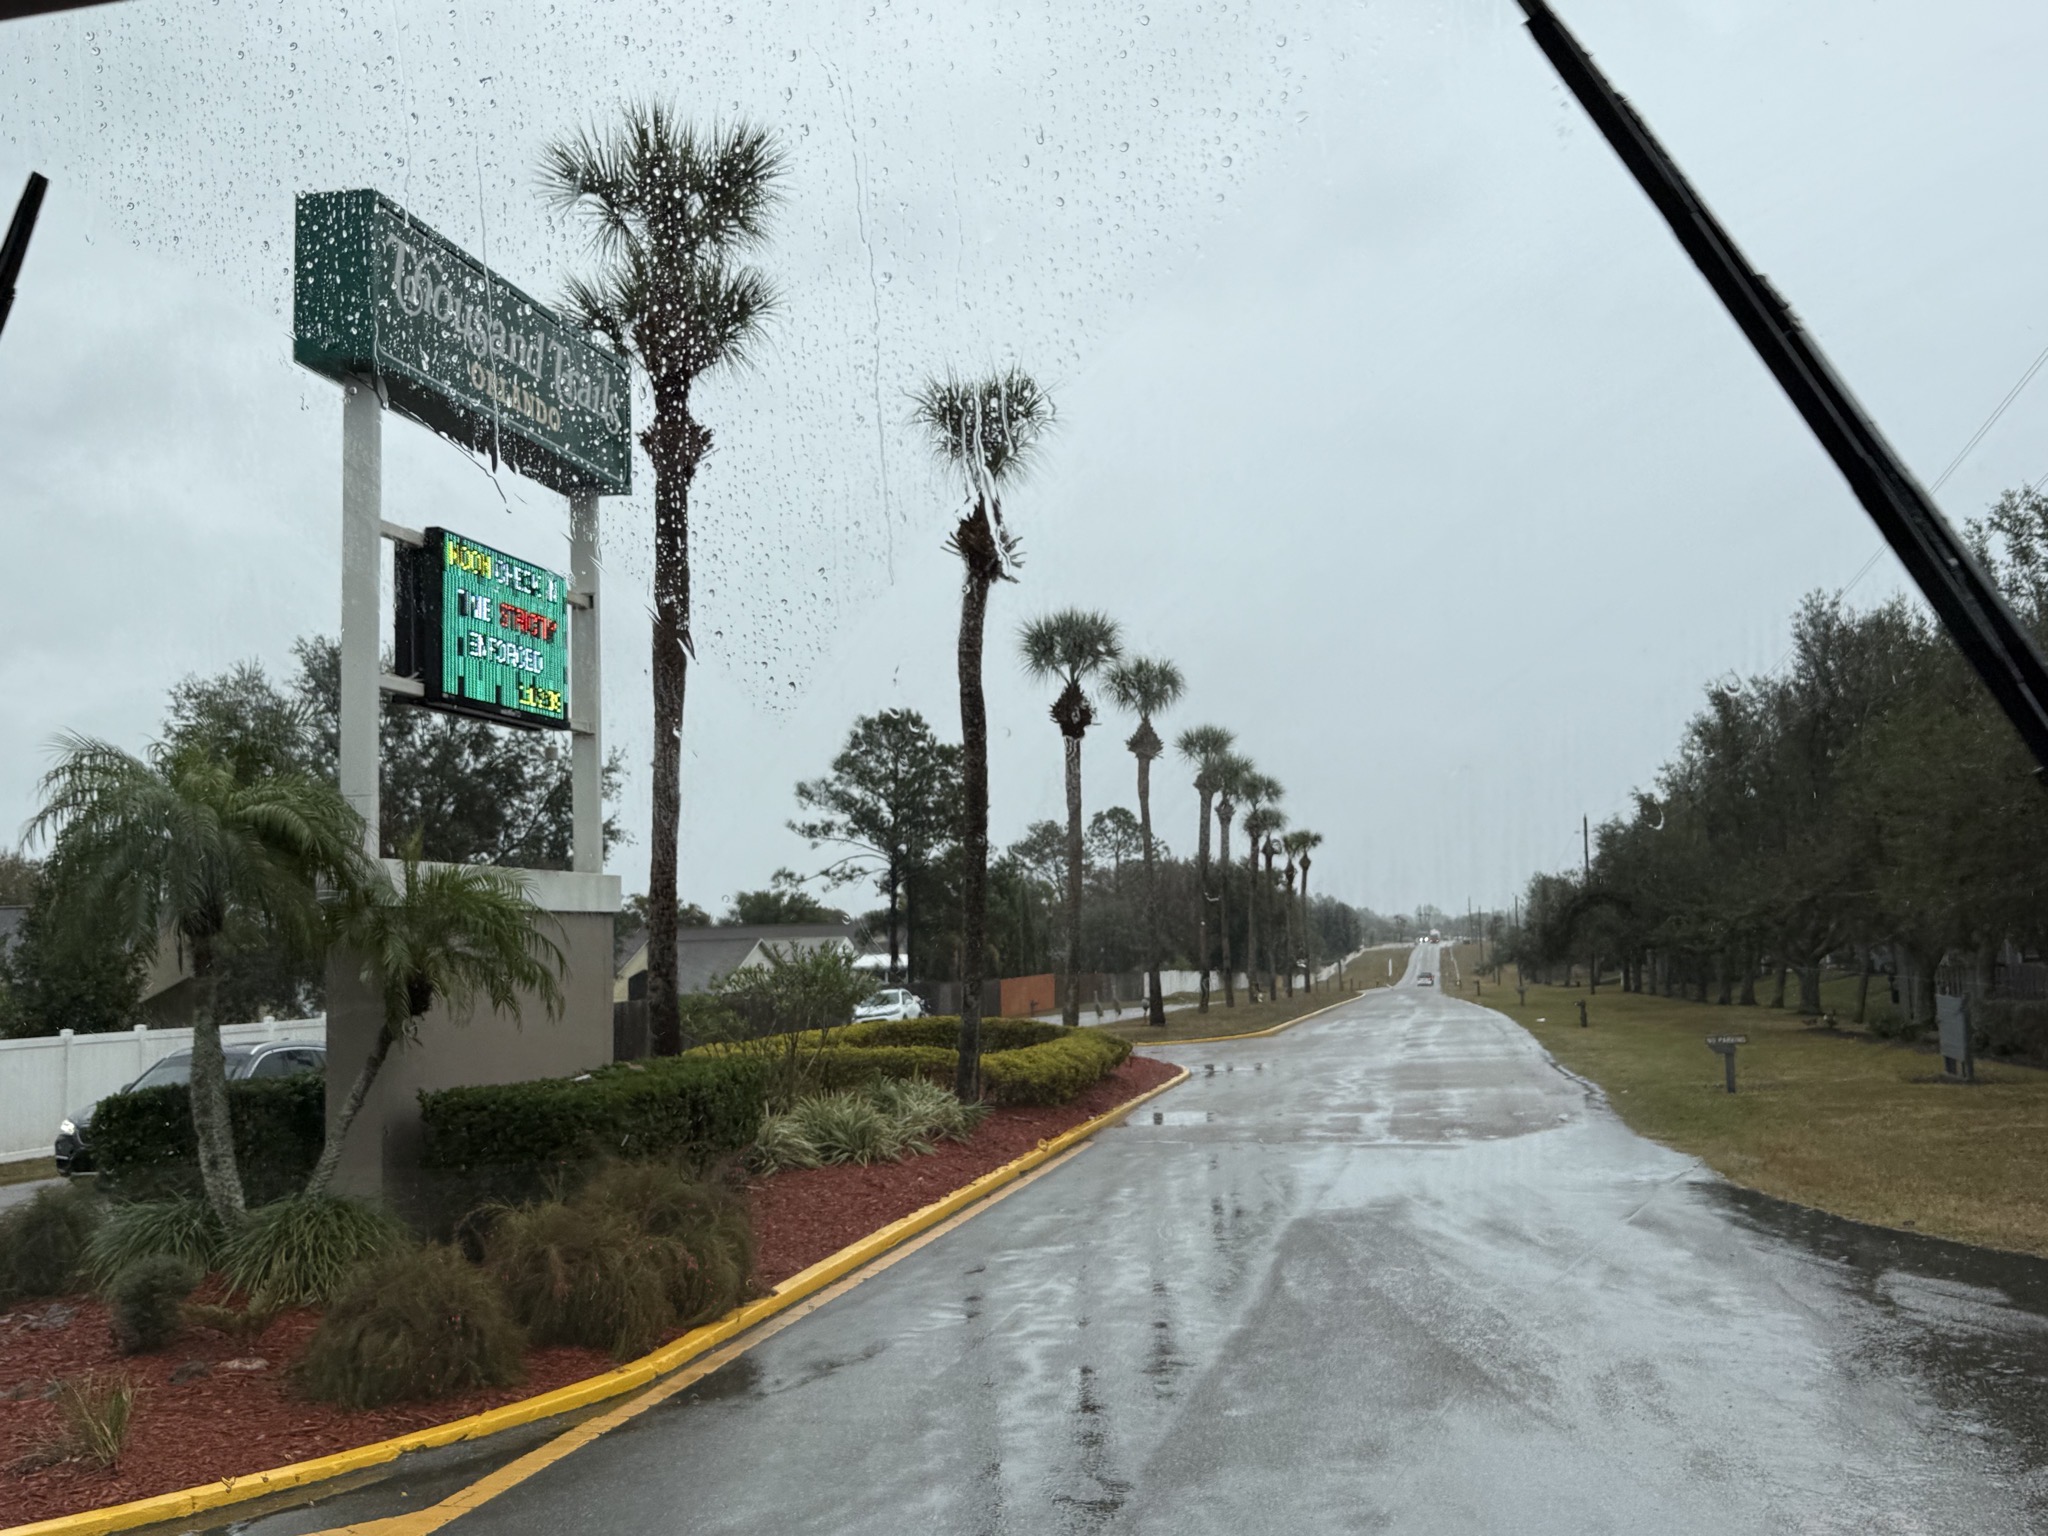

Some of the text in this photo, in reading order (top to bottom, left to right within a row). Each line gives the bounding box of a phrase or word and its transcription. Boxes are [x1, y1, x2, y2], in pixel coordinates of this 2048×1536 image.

[386, 235, 621, 436] Thousand Trails
[470, 361, 561, 433] ORLANDO
